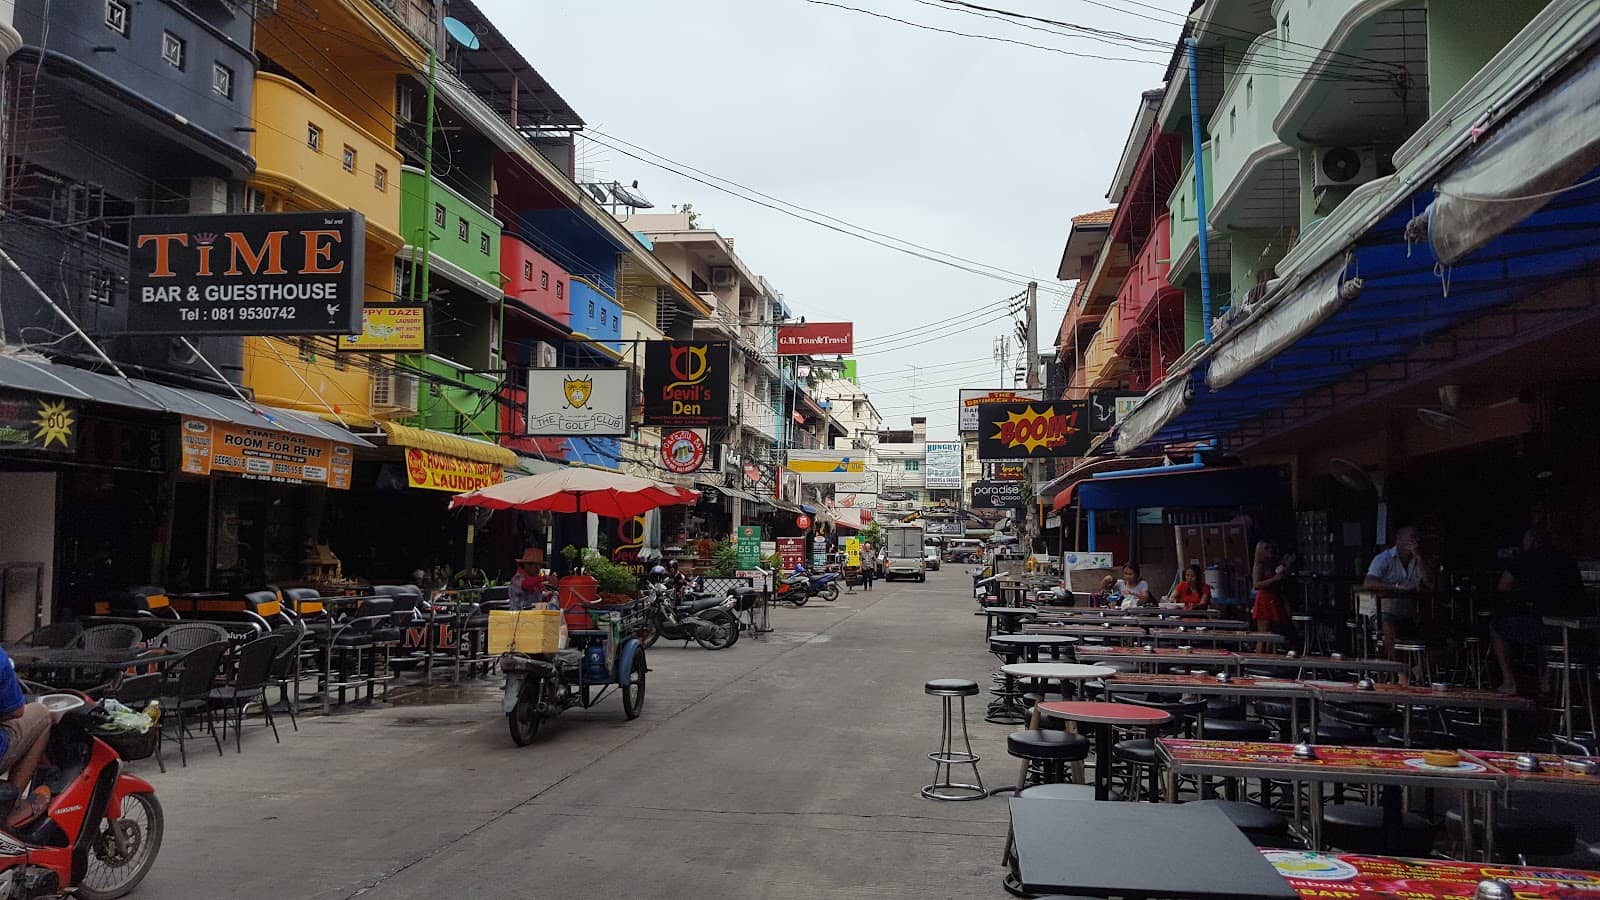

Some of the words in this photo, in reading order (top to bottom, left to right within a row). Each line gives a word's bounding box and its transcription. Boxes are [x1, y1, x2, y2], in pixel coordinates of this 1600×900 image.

[142, 286, 182, 302] BAR
[186, 286, 200, 301] &
[205, 283, 337, 301] GUESTHOUSE
[179, 308, 199, 321] Tel
[211, 308, 234, 320] 081
[239, 307, 296, 320] 9530742
[663, 384, 712, 400] Devil's
[672, 400, 701, 415] Den
[47, 412, 66, 430] 60
[536, 415, 556, 427] THE
[565, 422, 590, 430] GOLF
[596, 415, 621, 428] CLUB
[1000, 410, 1079, 445] BOOM!
[225, 433, 263, 448] ROOM
[267, 441, 290, 452] FOR
[294, 446, 322, 457] RENT
[431, 472, 489, 491] LAUNDRY
[974, 485, 1019, 497] paradise
